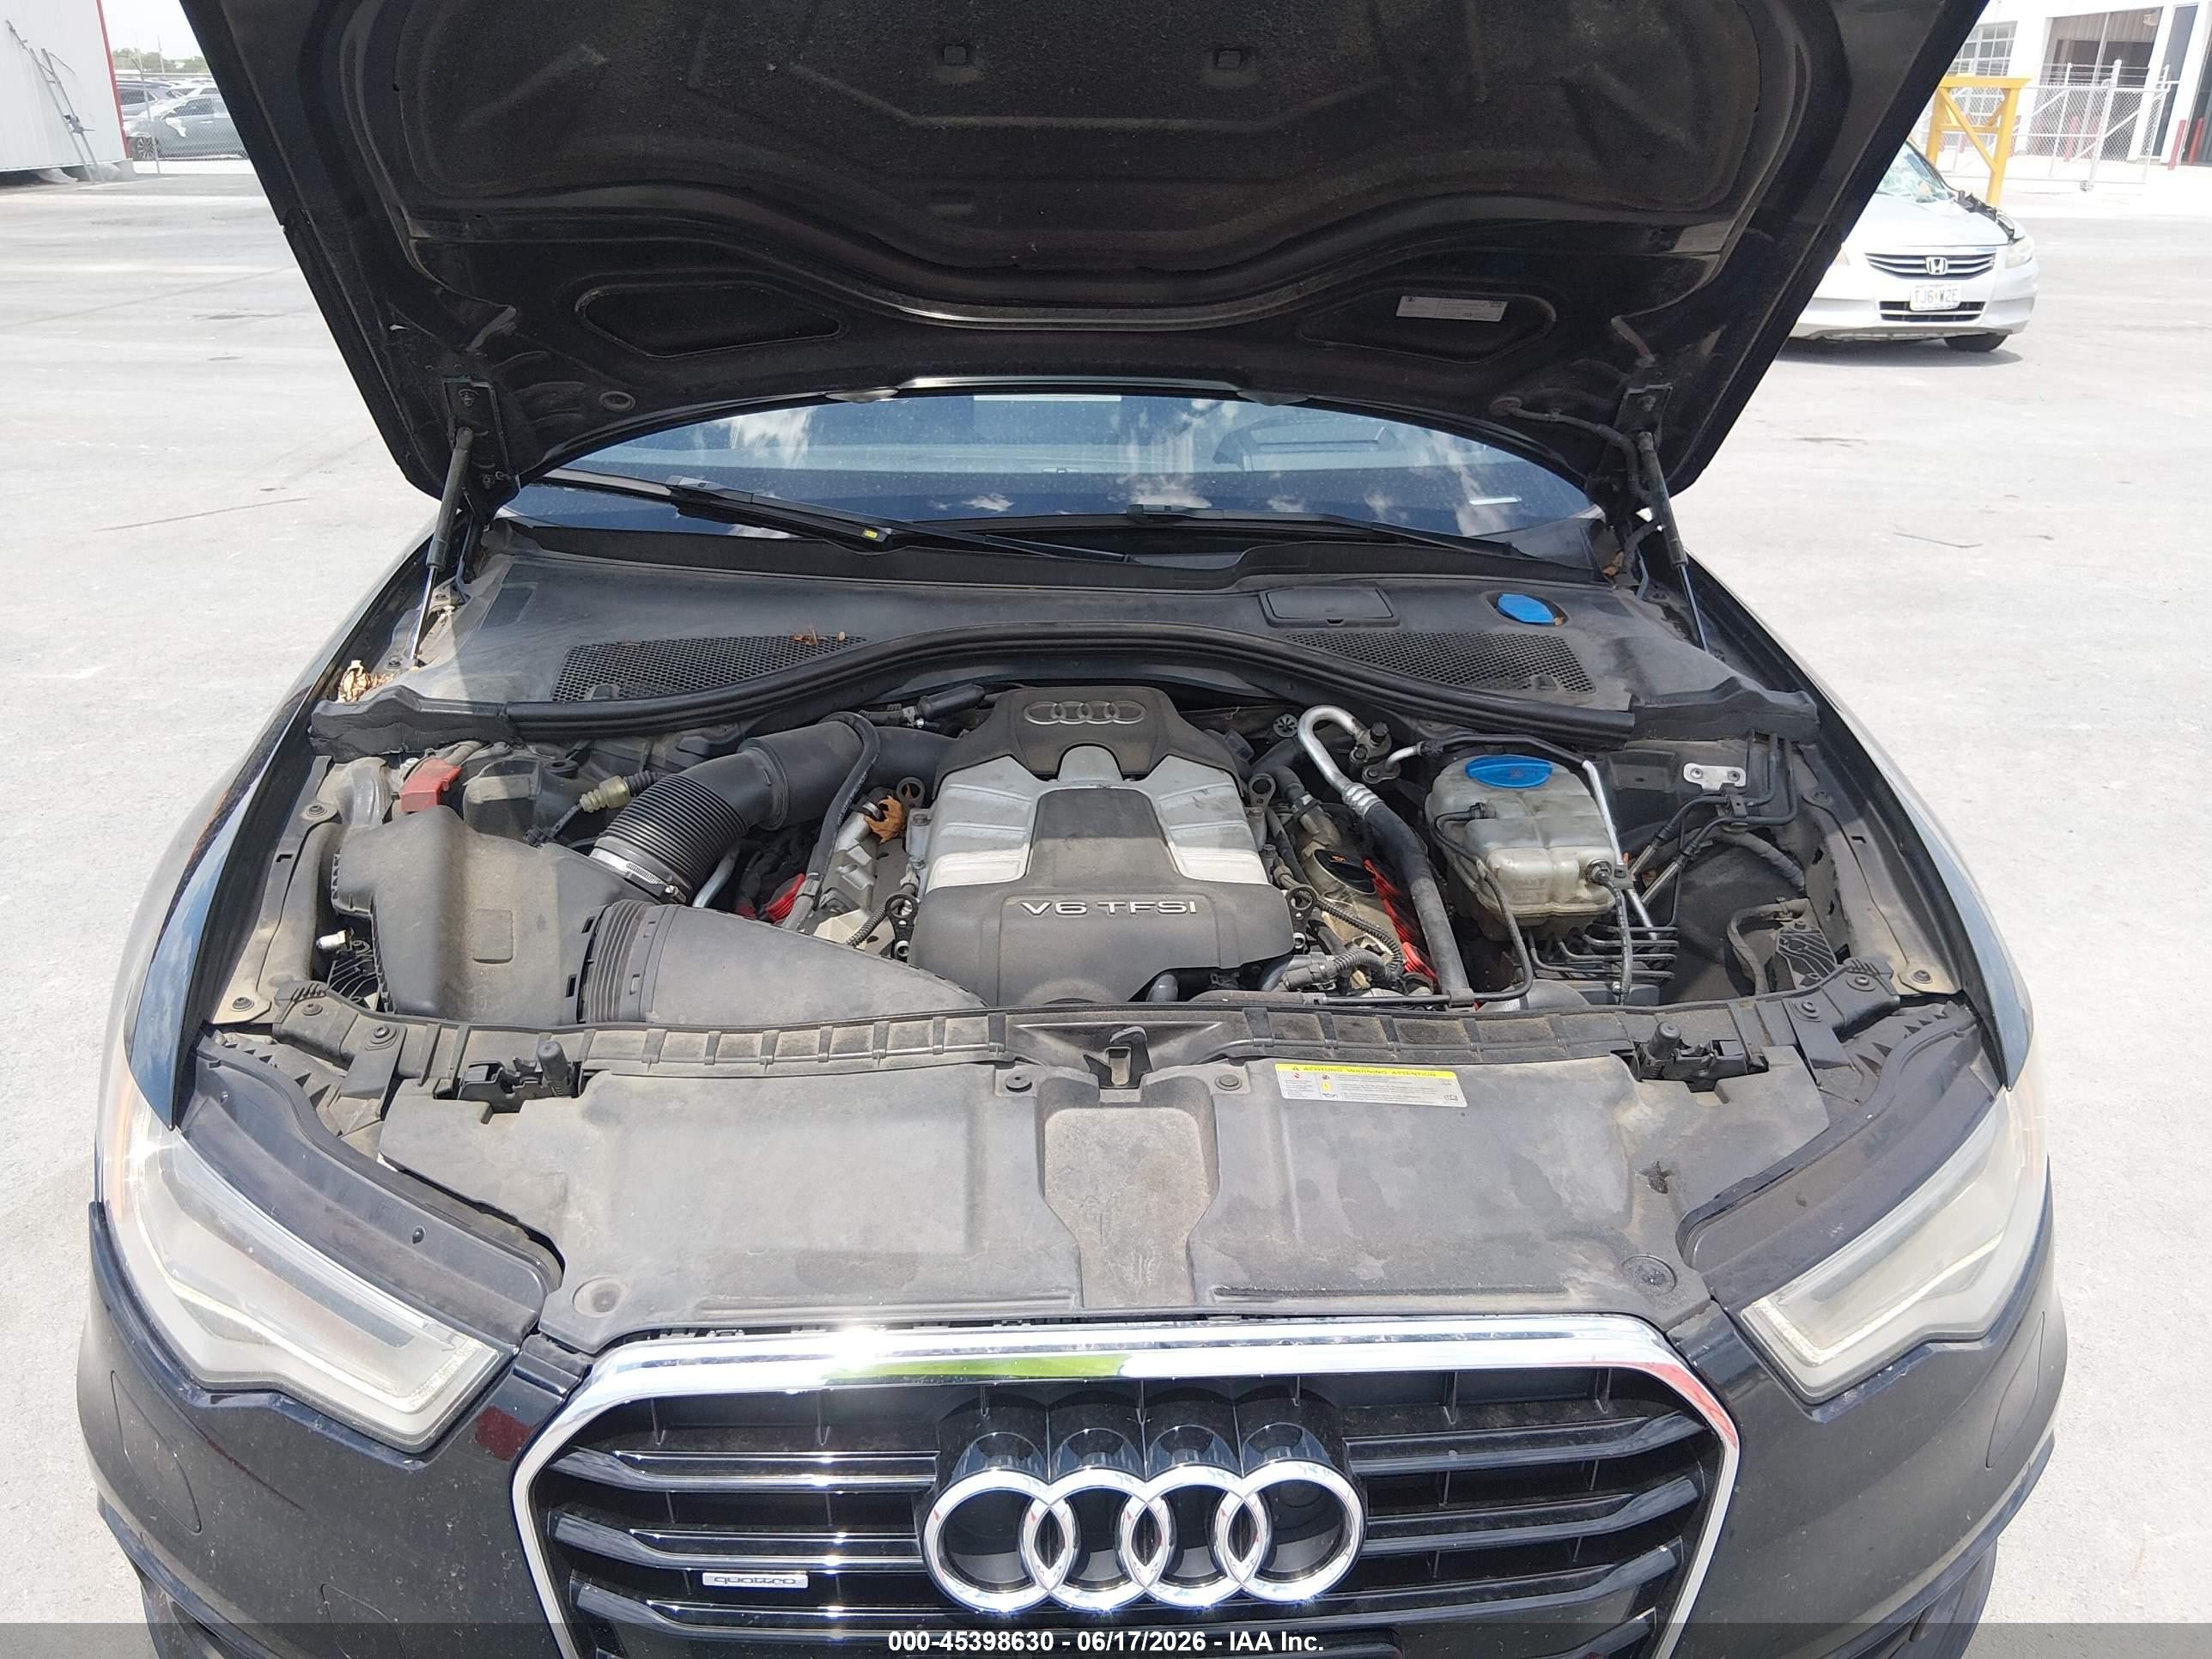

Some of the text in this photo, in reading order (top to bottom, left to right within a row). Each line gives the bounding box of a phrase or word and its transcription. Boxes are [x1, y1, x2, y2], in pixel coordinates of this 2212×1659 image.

[1020, 901, 1197, 915] V6 TFSI
[714, 1576, 797, 1585] quattro
